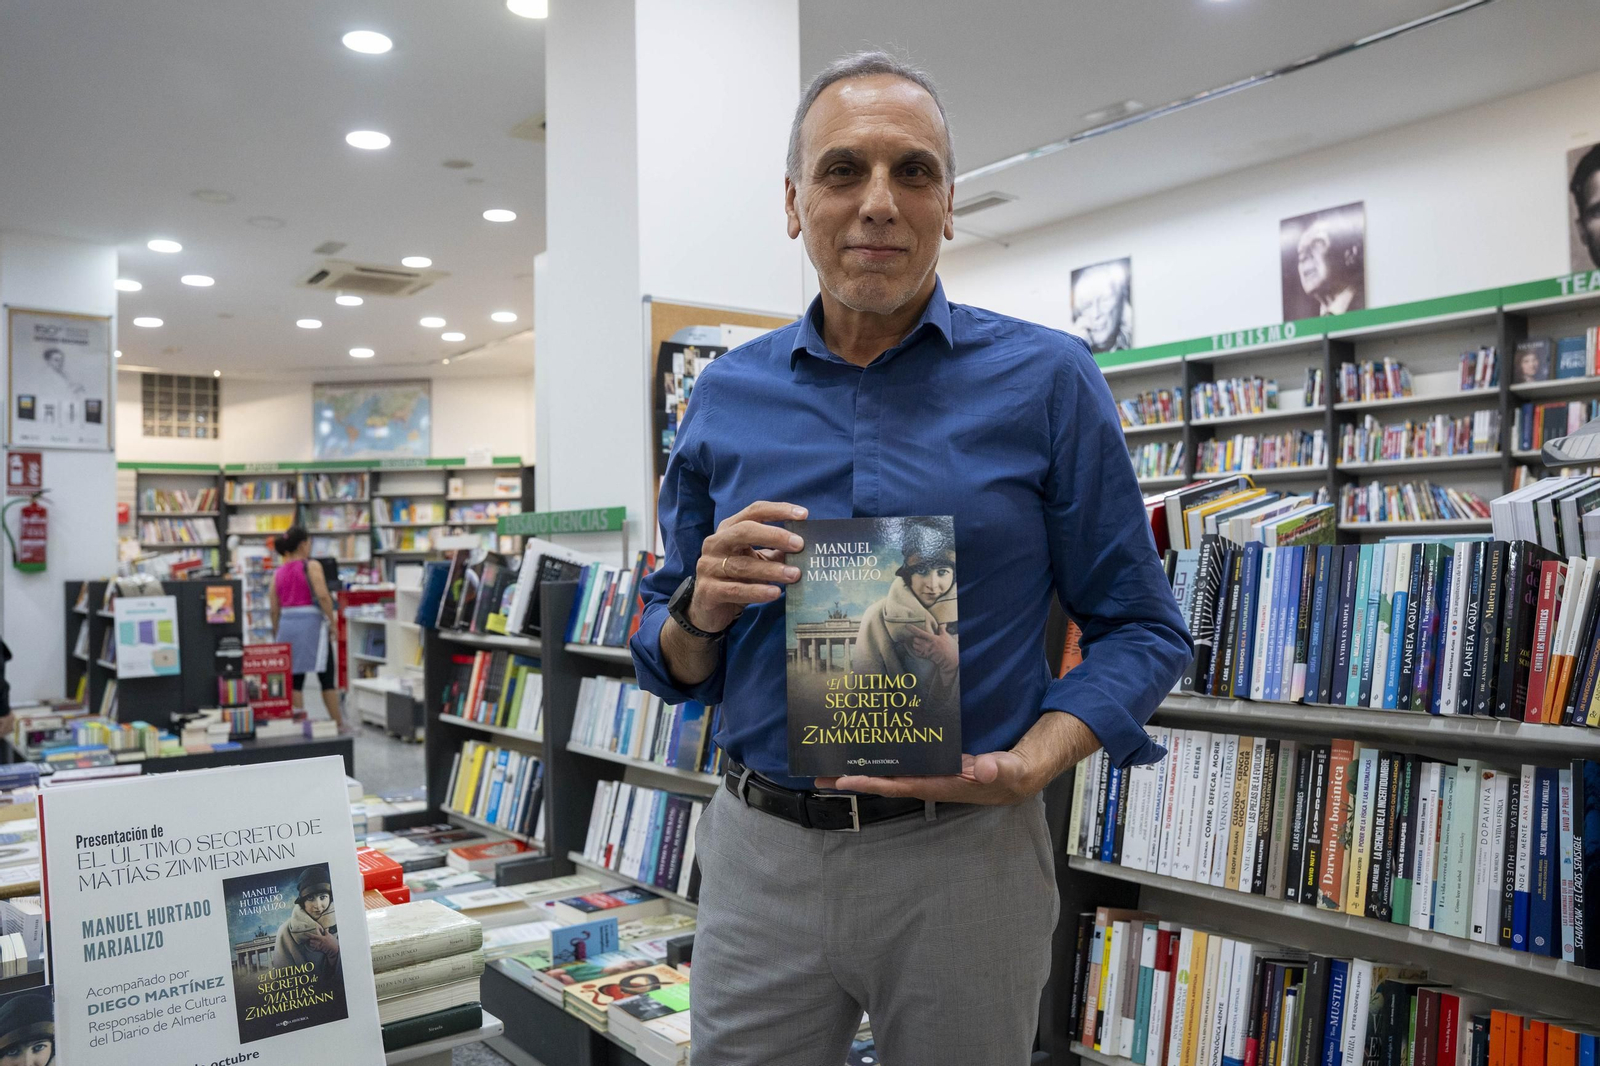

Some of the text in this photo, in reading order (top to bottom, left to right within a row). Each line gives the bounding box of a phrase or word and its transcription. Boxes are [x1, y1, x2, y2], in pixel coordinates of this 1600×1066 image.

[1556, 271, 1600, 296] TEA
[1211, 322, 1296, 351] TURISMO
[505, 509, 609, 533] ENSAYO CIENCIAS
[810, 556, 877, 568] HURTADO
[815, 542, 872, 554] MANUEL
[806, 569, 881, 583] MARJALIZO
[1192, 543, 1210, 635] BIENVENIDOS UNIVERSO
[1425, 571, 1433, 590] quiere
[1485, 549, 1499, 618] Materia oscura
[1241, 592, 1249, 630] NATURALEZA
[1423, 591, 1432, 613] cerebro
[1210, 641, 1218, 662] PILARES
[1216, 597, 1224, 624] CREACIÓN
[1422, 614, 1430, 622] Tu
[1240, 639, 1246, 647] DE
[1338, 656, 1344, 665] LA
[1341, 629, 1347, 637] ES
[1361, 608, 1376, 680] La vida en cuatro letras
[1403, 600, 1417, 673] PLANETA AQUA
[1462, 601, 1478, 677] PLANETA AQUA
[1534, 608, 1549, 671] CONTAR LAS MATEMÁTICAS
[827, 671, 917, 690] El ÚLTIMO
[825, 692, 921, 709] SECRETO de
[831, 708, 913, 729] MATÍAS
[801, 725, 943, 744] ZIMMERMANN
[872, 758, 900, 766] HISTÓRICA
[1242, 750, 1250, 776] PODER
[1252, 744, 1262, 775] EVOLUCIÓN
[1204, 741, 1220, 837] COMER, DEFECAR, MORIR
[1219, 740, 1234, 831] VENENOS LITERARIOS
[1232, 791, 1240, 825] CUANDO
[1236, 750, 1244, 781] CIENCIA
[1363, 759, 1371, 790] MATEMÁTICAS
[1511, 783, 1519, 795] LA
[1522, 775, 1530, 801] IBÁÑEZ
[1250, 791, 1258, 811] PIEZAS
[1333, 765, 1344, 822] botánica
[1248, 812, 1256, 822] LAS
[1373, 758, 1390, 859] LA CIENCIA DE LA INCERTIDUMBRE
[1480, 787, 1491, 844] DOPAMINA
[1509, 798, 1518, 828] CUEVA
[76, 823, 163, 848] Presentación de
[1330, 823, 1338, 831] la
[1509, 830, 1516, 838] DE
[77, 818, 321, 870] EL ÚLTIMO SECRETO DE
[1520, 852, 1526, 860] TU
[78, 843, 295, 891] MATÍAS ZIMMERMANN
[1322, 839, 1336, 884] Darwin
[1372, 864, 1380, 882] PALMER
[1505, 854, 1514, 898] HUESOS
[239, 893, 283, 908] HURTADO
[242, 886, 280, 899] MANUEL
[1382, 876, 1390, 904] LAWRENCE
[1573, 835, 1582, 948] SCHWENK EL CAOS SENSIBLE
[81, 899, 211, 938] MANUEL HURTADO
[238, 901, 286, 917] MARJALIZO
[83, 930, 165, 962] MARJALIZO
[85, 970, 189, 1000] Acompañado por
[257, 974, 319, 995] SECRETO de
[268, 961, 315, 980] ÚLTIMO
[87, 974, 225, 1015] DIEGO MARTÍNEZ
[245, 991, 334, 1021] ZIMMERMANN
[263, 986, 315, 1007] MATÍAS
[1329, 973, 1343, 1026] MUSTILL
[1353, 971, 1361, 1013] GODFREY-SMITH
[88, 992, 226, 1035] Responsable de Cultura
[89, 1009, 215, 1047] del Diario de Almería
[210, 1050, 260, 1066] octubre
